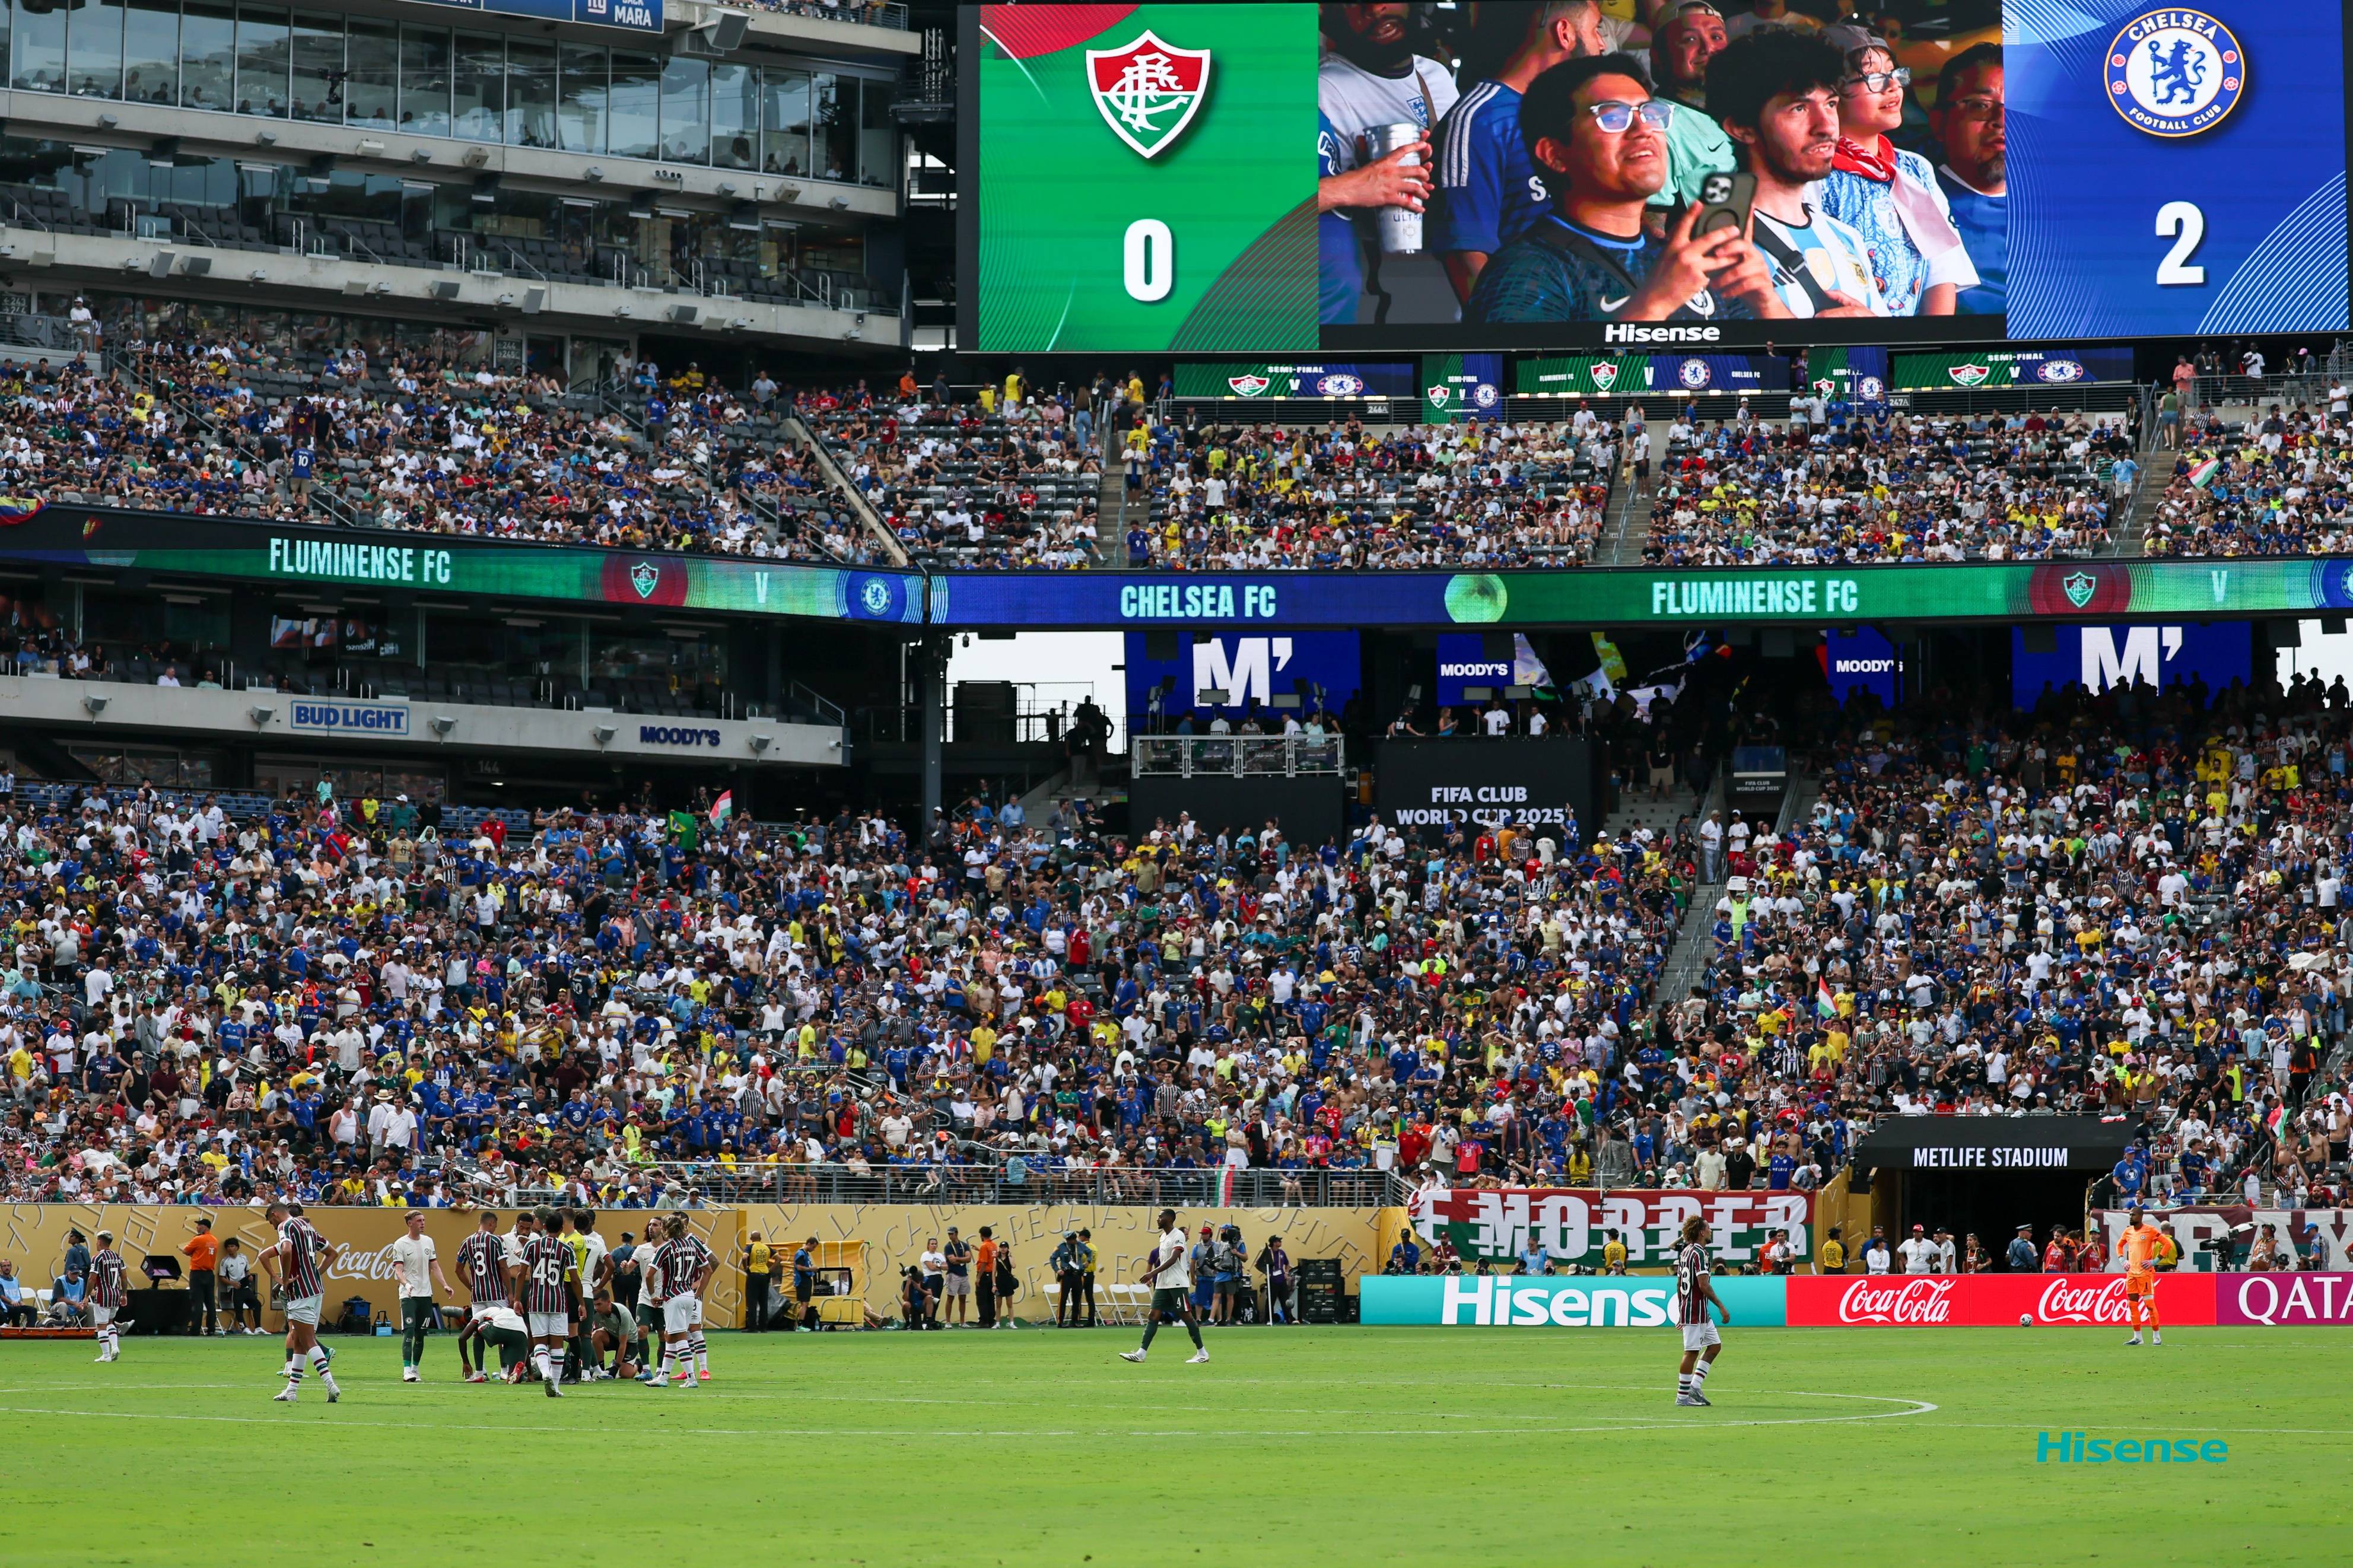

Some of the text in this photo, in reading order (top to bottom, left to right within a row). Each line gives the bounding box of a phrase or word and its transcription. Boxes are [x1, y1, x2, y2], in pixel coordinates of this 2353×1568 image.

[614, 7, 652, 27] MARA
[2128, 12, 2218, 42] CHELSEA
[2129, 104, 2222, 131] FOOTBALL CLUB
[2156, 202, 2203, 284] 2
[1124, 219, 1172, 301] 0
[1605, 324, 1720, 342] Hisense
[1988, 353, 2044, 361] SEMI-FINAL
[1644, 367, 1654, 386] V
[2009, 367, 2021, 379] V
[1289, 379, 1300, 390] V
[1459, 389, 1465, 400] V
[1844, 381, 1850, 393] V
[1368, 405, 1388, 414] 246A
[1889, 398, 1909, 406] 247A
[298, 455, 309, 467] 10
[270, 538, 451, 584] FLUMINENSE FC
[754, 571, 768, 603] V
[2211, 571, 2227, 602] V
[1121, 586, 1275, 617] CHELSEA FC
[1653, 579, 1859, 615] FLUMINENSE FC
[296, 705, 405, 730] BUD LIGHT
[1432, 787, 1527, 802] FIFA CLUB
[1396, 809, 1467, 825] WORLD
[1515, 807, 1566, 825] 2025
[1348, 950, 1360, 962] 20
[1914, 1147, 2068, 1167] METLIFE STADIUM
[327, 1242, 398, 1280] Coca-Co
[474, 1251, 487, 1276] 3
[674, 1255, 695, 1282] 17
[110, 1267, 119, 1289] 7
[533, 1258, 560, 1286] 45
[1176, 1297, 1181, 1306] 4
[1840, 1278, 1957, 1323] Coca-Cola
[421, 1318, 430, 1327] 10
